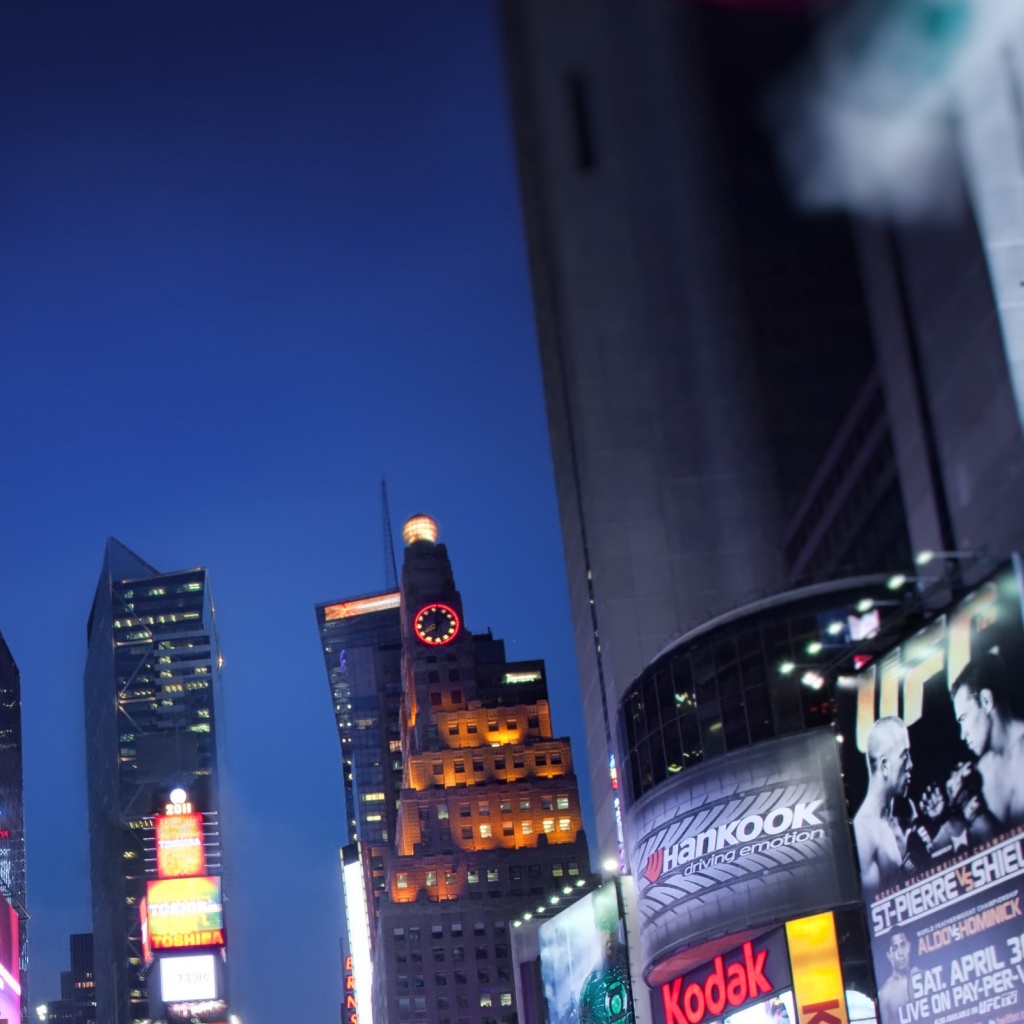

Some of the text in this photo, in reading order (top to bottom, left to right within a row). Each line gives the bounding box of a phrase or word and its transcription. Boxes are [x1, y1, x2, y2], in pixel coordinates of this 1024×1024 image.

[165, 803, 191, 815] 2011
[684, 829, 825, 877] driving emotion
[871, 871, 959, 932] ST-PIERRE
[152, 931, 224, 949] TOSHIBA
[918, 927, 952, 956] ALDO
[958, 897, 1022, 939] HOMINICK
[178, 971, 209, 984] TDK
[911, 965, 947, 999] SAT.
[951, 945, 1005, 987] APRIL
[898, 997, 930, 1024] LIVE
[931, 989, 952, 1014] ON
